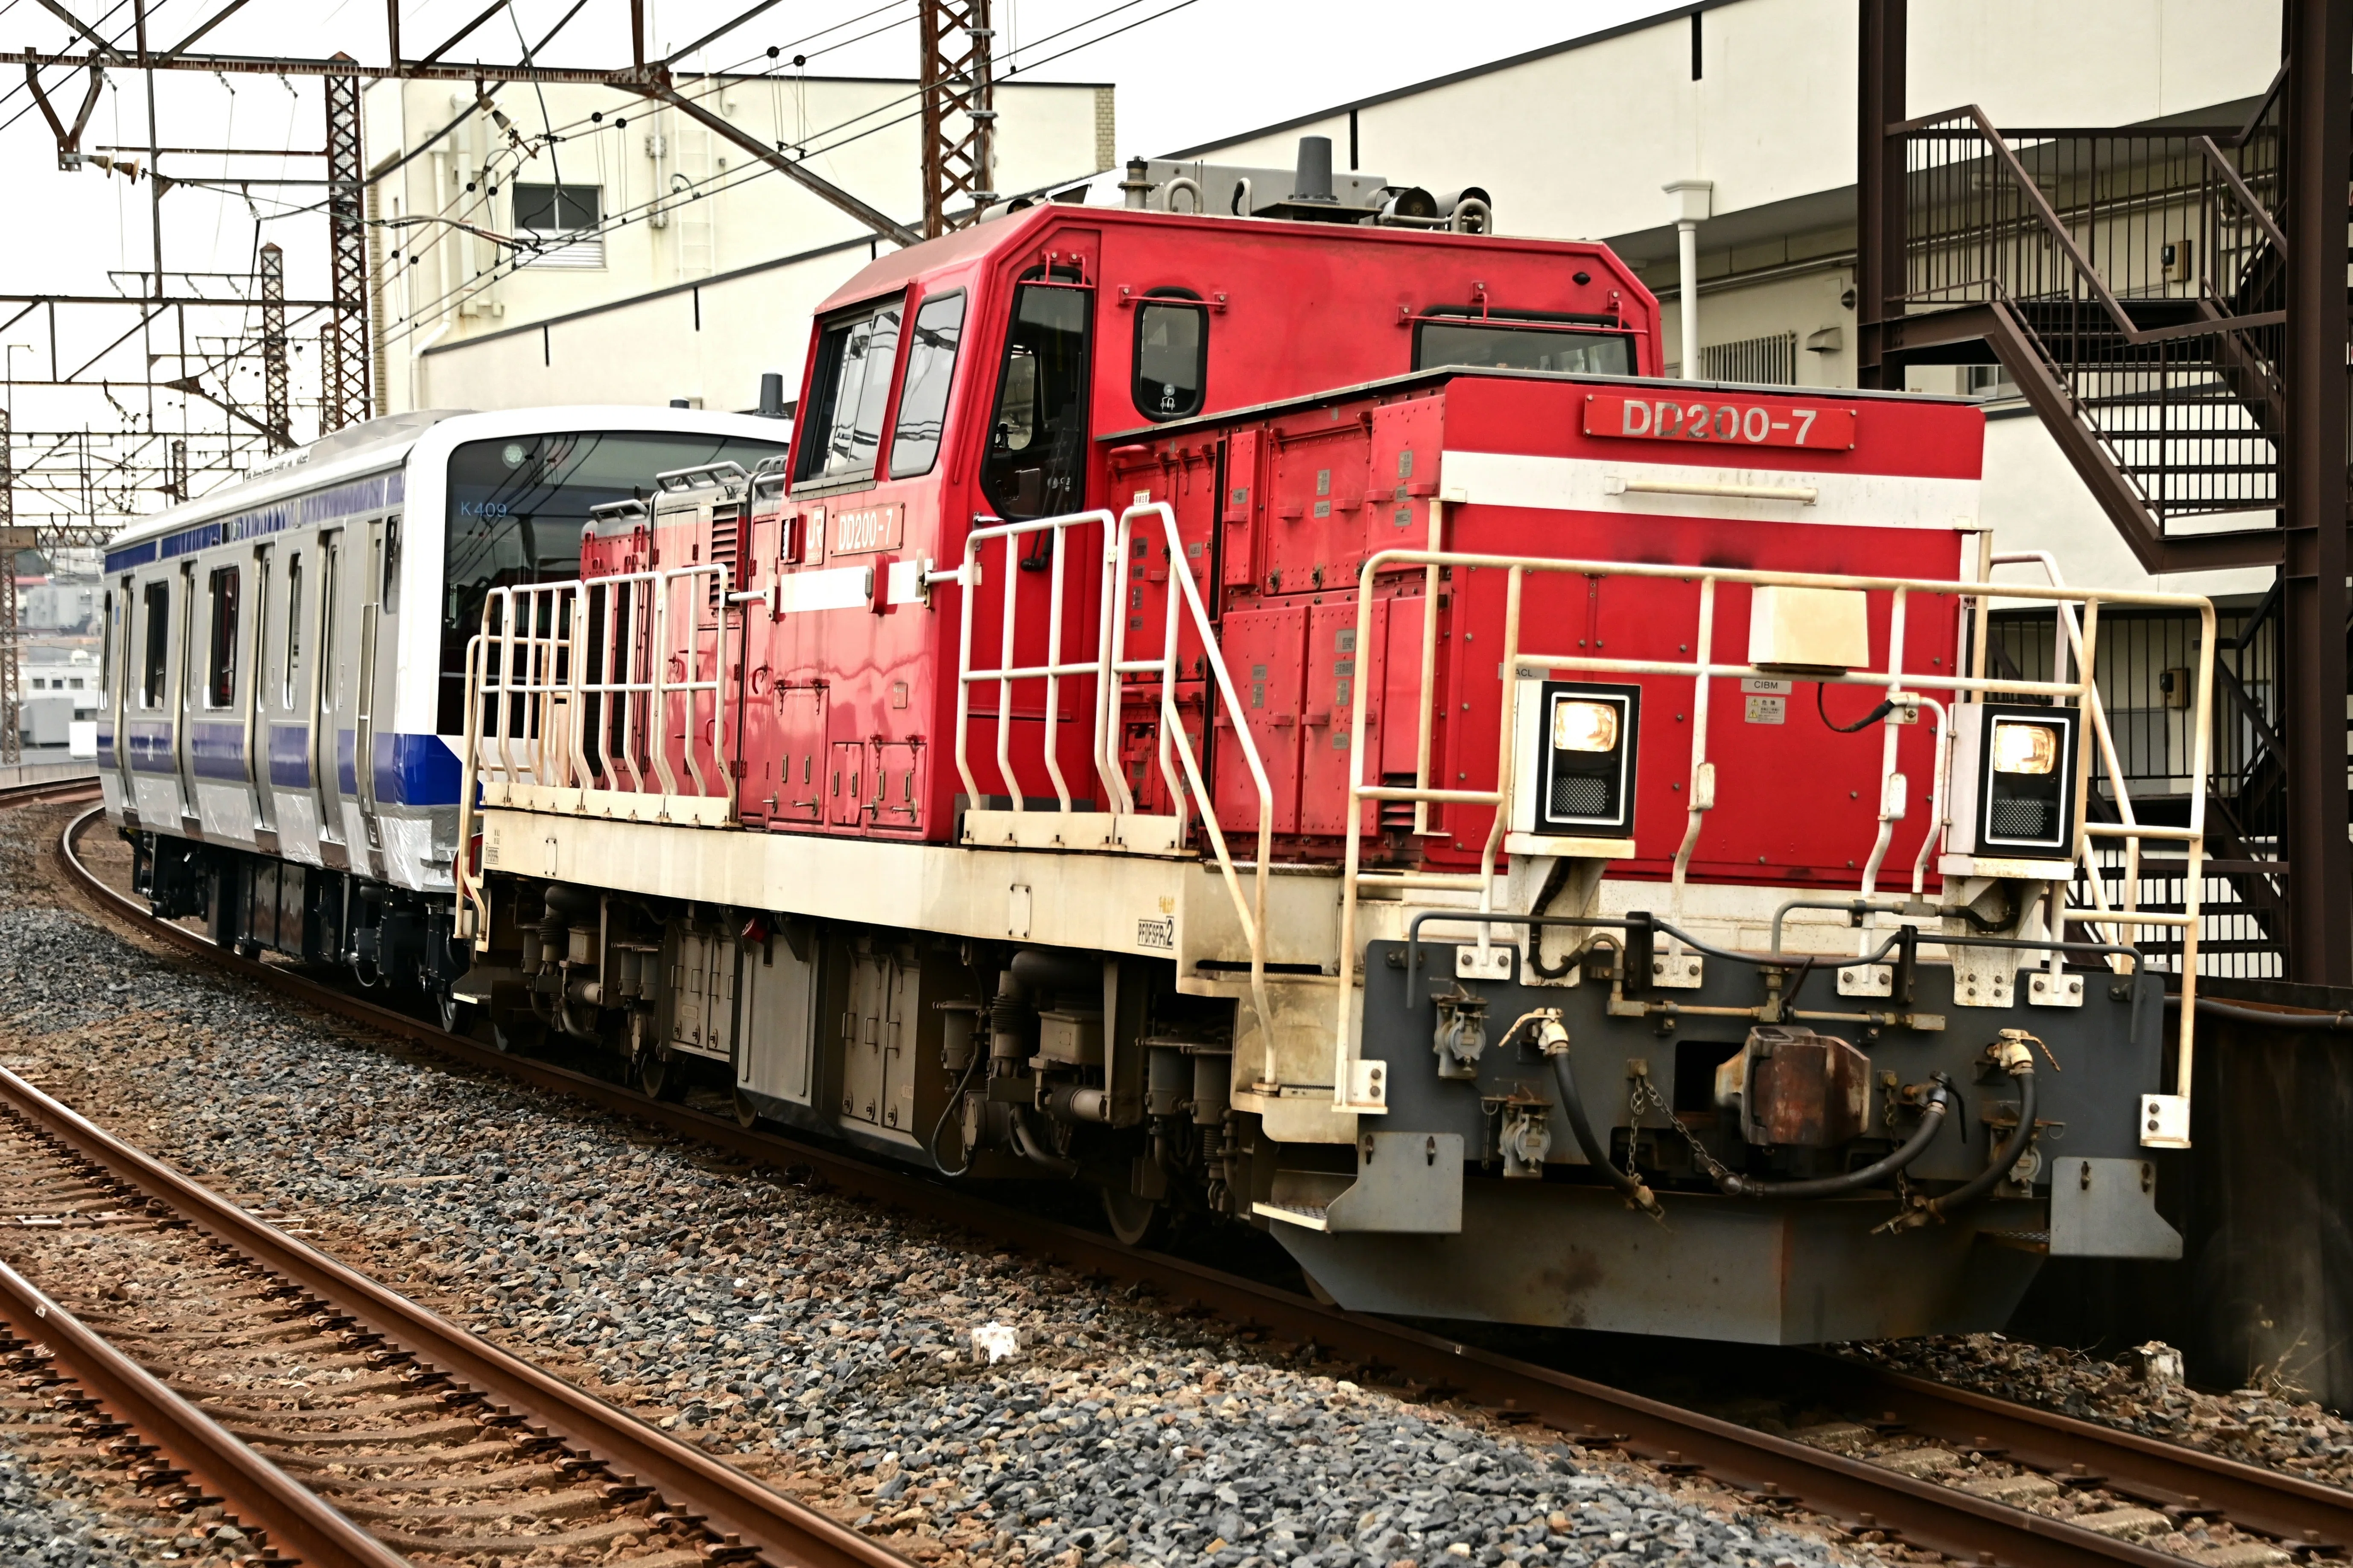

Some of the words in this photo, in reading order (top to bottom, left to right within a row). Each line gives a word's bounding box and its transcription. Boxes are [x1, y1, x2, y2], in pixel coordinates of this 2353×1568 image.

[1622, 400, 1817, 445] DD200-7
[806, 510, 823, 550] JR
[838, 508, 893, 551] DD200-7
[1516, 669, 1533, 677] ACL
[1754, 681, 1778, 689] CIBM
